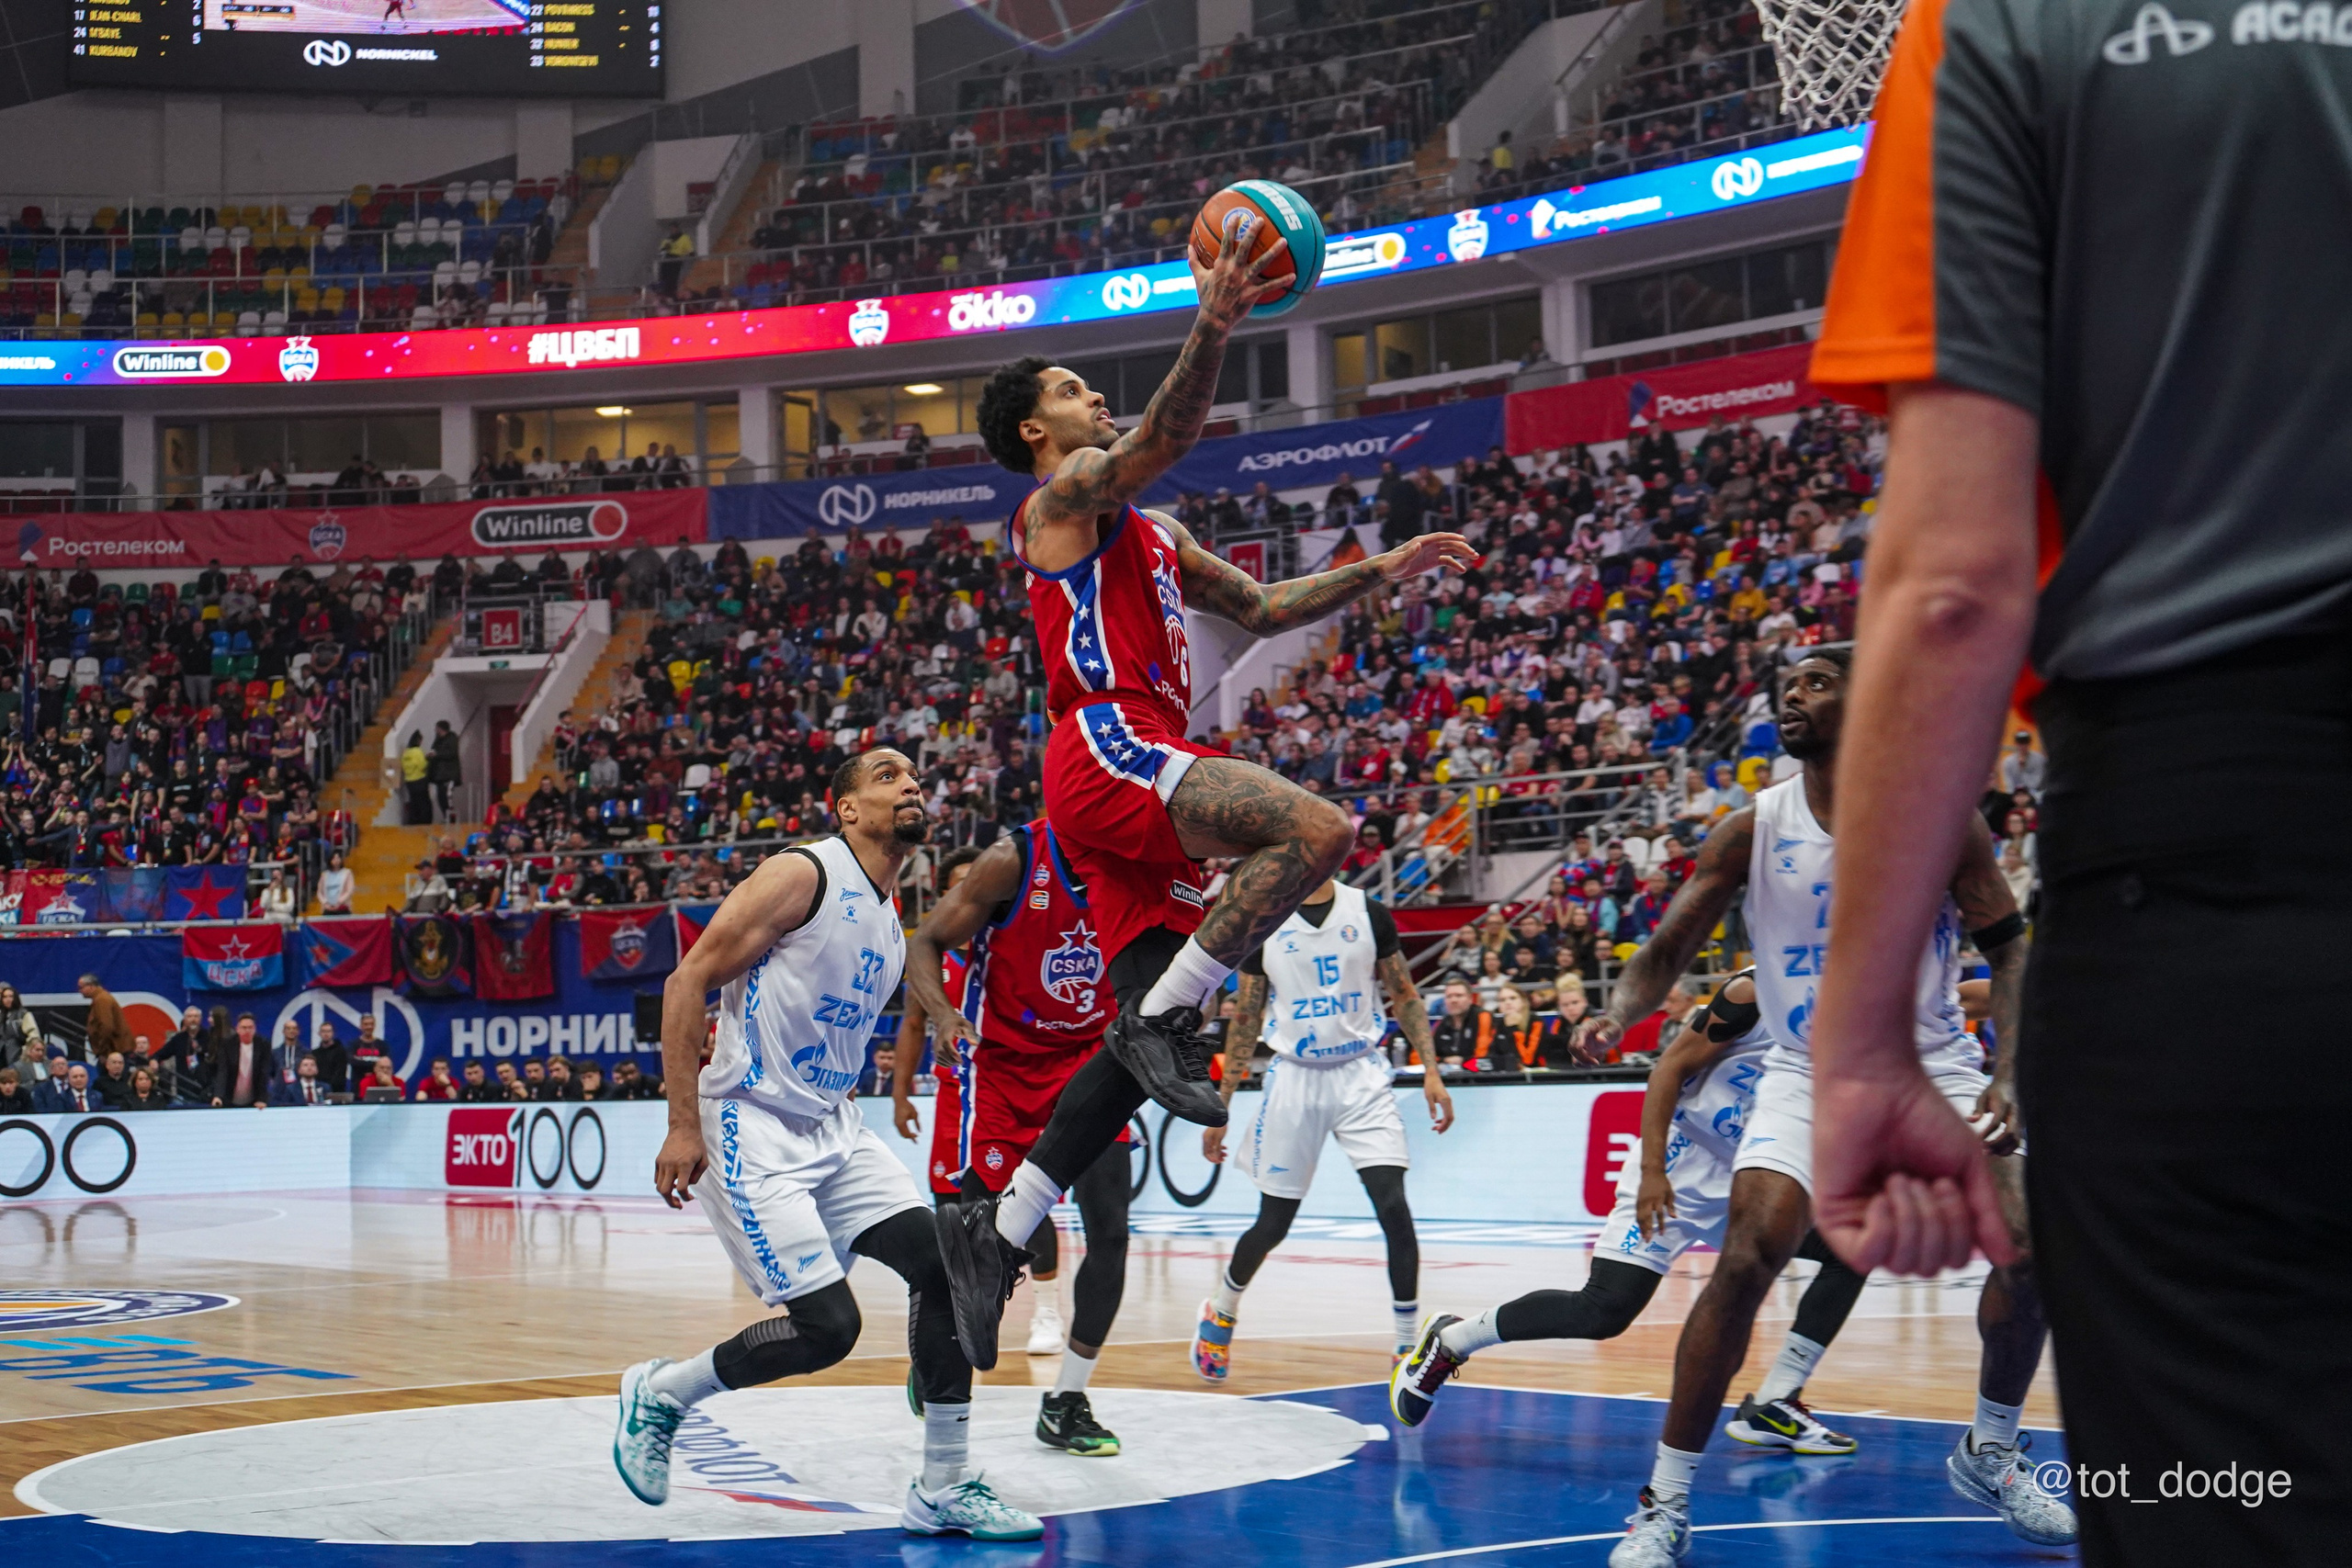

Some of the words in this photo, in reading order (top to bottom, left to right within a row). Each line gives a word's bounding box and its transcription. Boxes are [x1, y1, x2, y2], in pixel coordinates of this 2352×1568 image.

[356, 49, 438, 61] NORNICKEL
[124, 354, 198, 370] Winline
[1657, 380, 1794, 418] Ростелеком
[1238, 435, 1390, 472] АЭРОФЛОТ
[885, 485, 996, 509] НОРНИКЕЛЬ
[486, 513, 582, 536] Winline
[49, 536, 185, 556] Ростелеком
[208, 959, 262, 987] ЦСКА
[1050, 956, 1096, 974] CSKA
[1313, 954, 1340, 987] 15
[1076, 989, 1096, 1013] 3
[451, 1012, 662, 1057] НОРНИК
[452, 1134, 507, 1166] ЭКТО
[512, 1107, 605, 1190] 100
